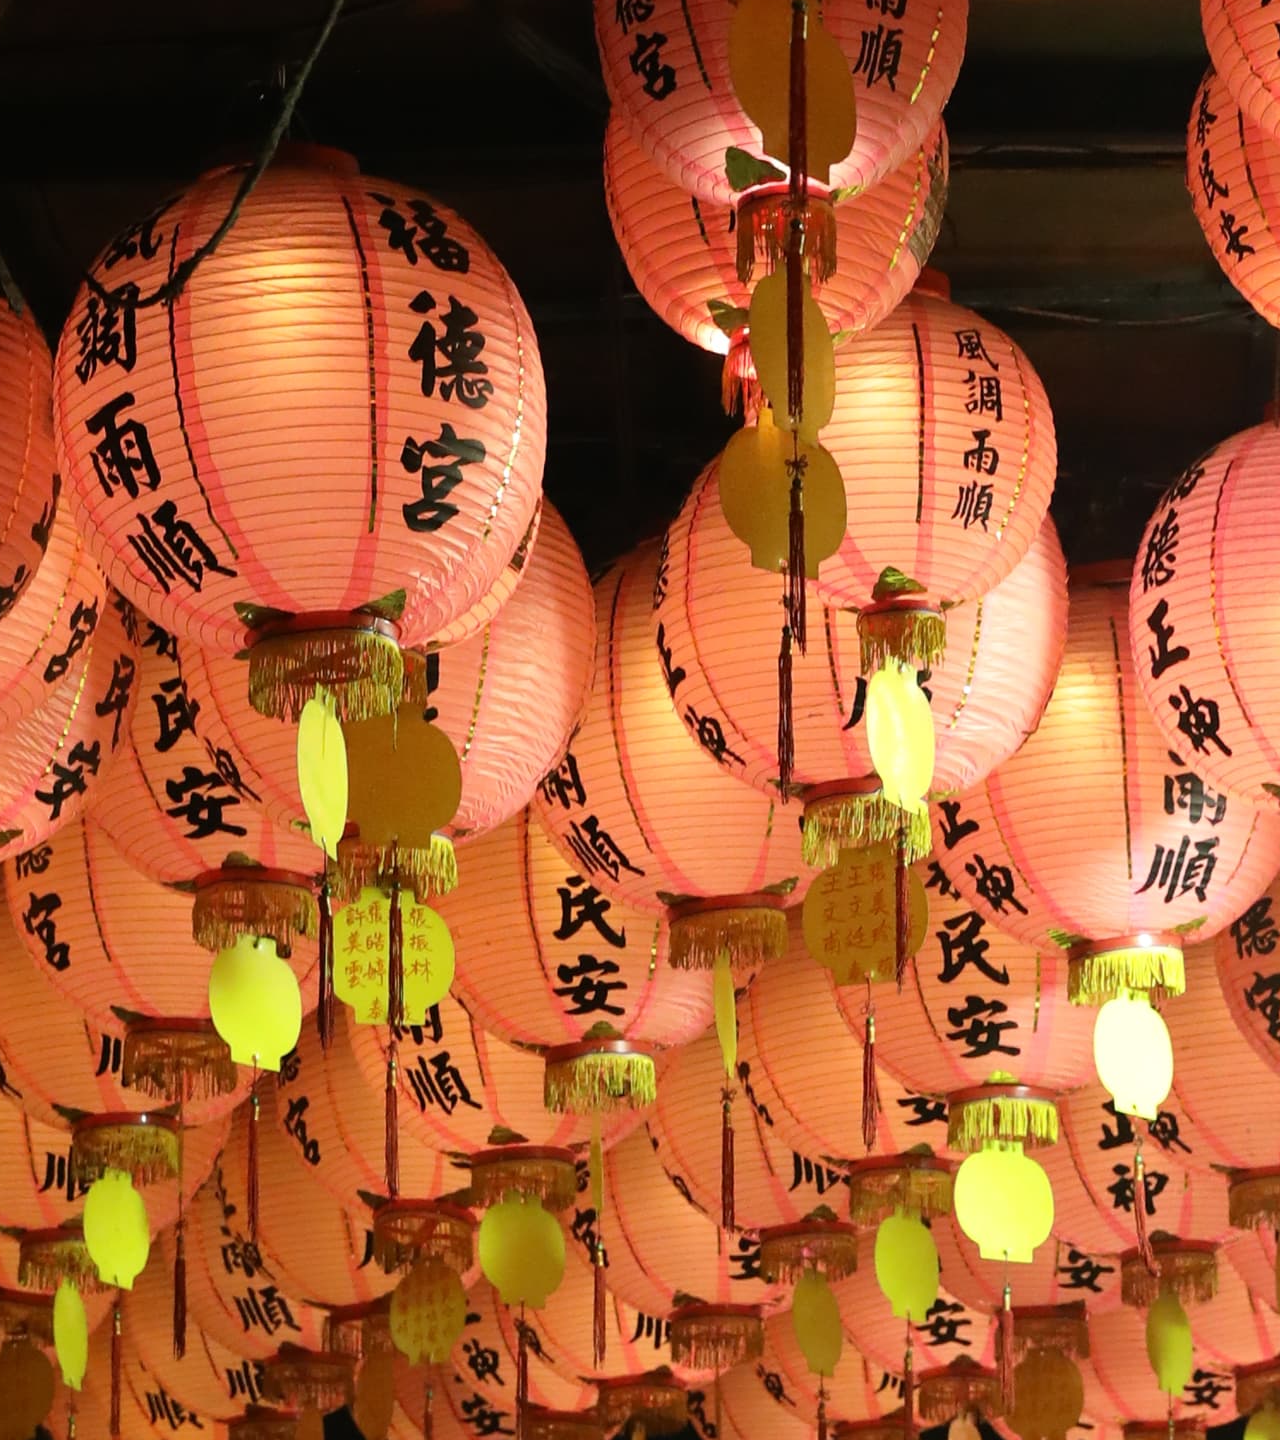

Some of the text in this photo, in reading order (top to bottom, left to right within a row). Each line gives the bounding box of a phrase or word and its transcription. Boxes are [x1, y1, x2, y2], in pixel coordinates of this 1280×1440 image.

[1193, 89, 1256, 262] 泰民安
[75, 195, 237, 595] 風調雨順
[367, 191, 494, 532] 福德宮
[952, 329, 1003, 533] 風調雨順
[1142, 460, 1233, 757] 福德正神
[553, 874, 628, 1017] 民安
